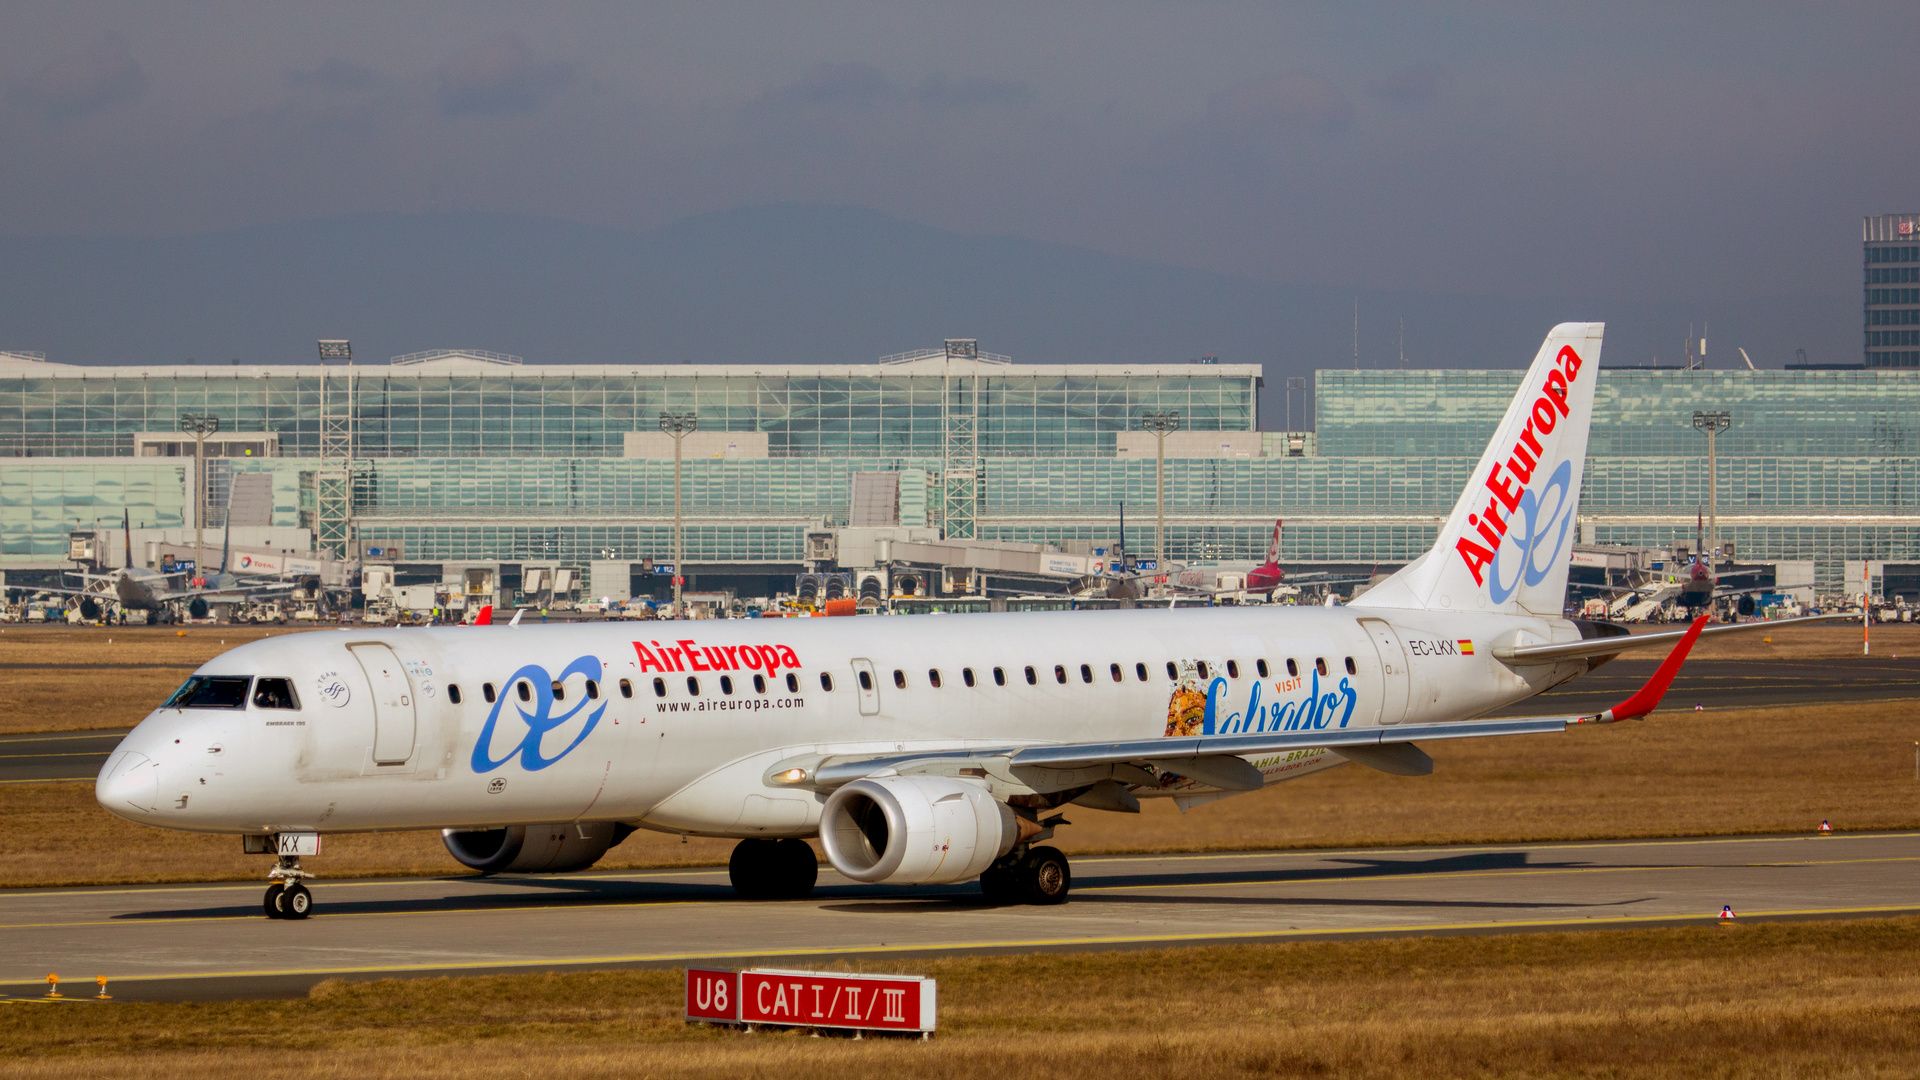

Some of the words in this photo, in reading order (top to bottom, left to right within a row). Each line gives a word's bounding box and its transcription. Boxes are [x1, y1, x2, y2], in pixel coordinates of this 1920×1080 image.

[1456, 345, 1582, 588] AirEuropa
[176, 562, 182, 570] V
[254, 561, 276, 569] TOTAL
[1409, 640, 1458, 655] EC-LKX
[632, 640, 802, 678] AirEuropa
[1275, 678, 1302, 694] VISIT
[656, 698, 804, 712] www.aireuropa.com
[281, 835, 300, 853] KX
[697, 978, 728, 1012] U8
[757, 981, 803, 1017] CAT
[811, 984, 906, 1023] I/II/III
